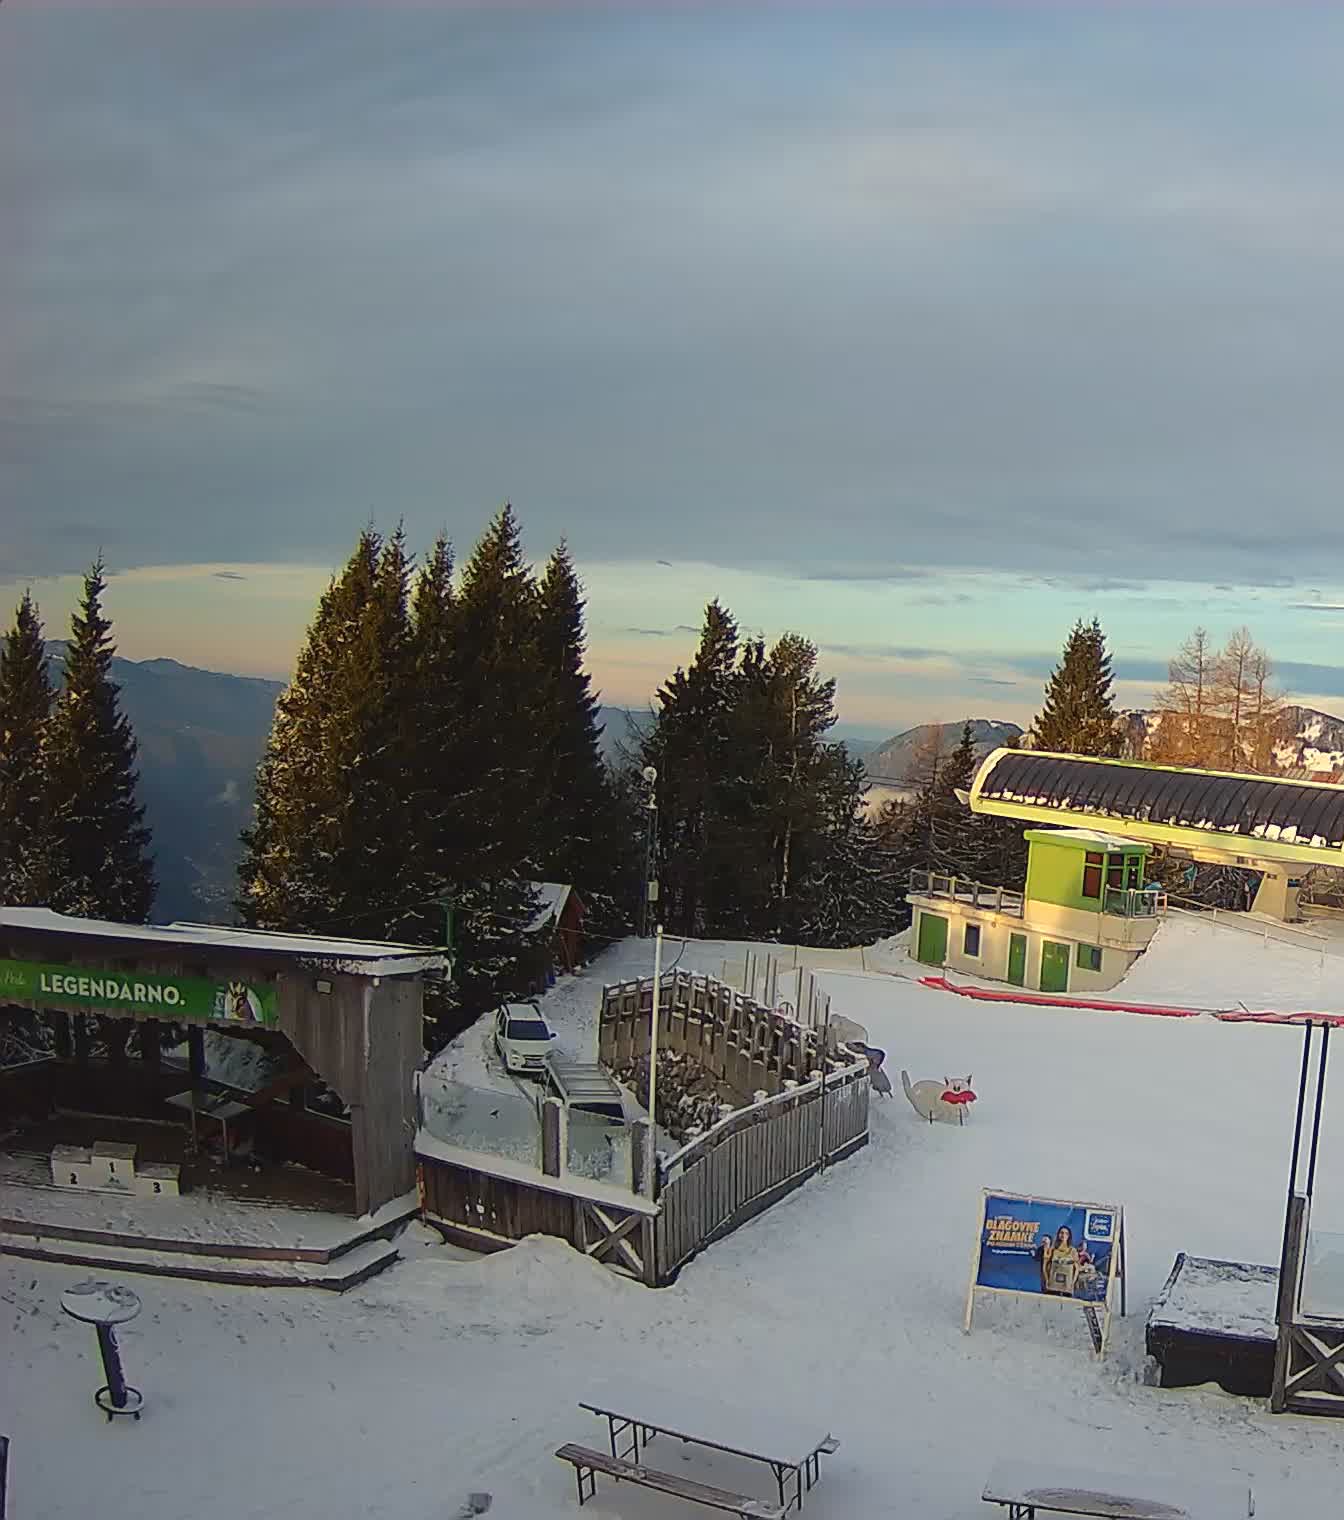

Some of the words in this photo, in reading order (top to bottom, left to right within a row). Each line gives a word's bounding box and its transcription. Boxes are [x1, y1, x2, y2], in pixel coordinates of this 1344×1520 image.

[40, 973, 186, 1006] LEGENDARNO.
[109, 1161, 115, 1173] 1
[70, 1172, 78, 1185] 2
[152, 1181, 161, 1193] 3
